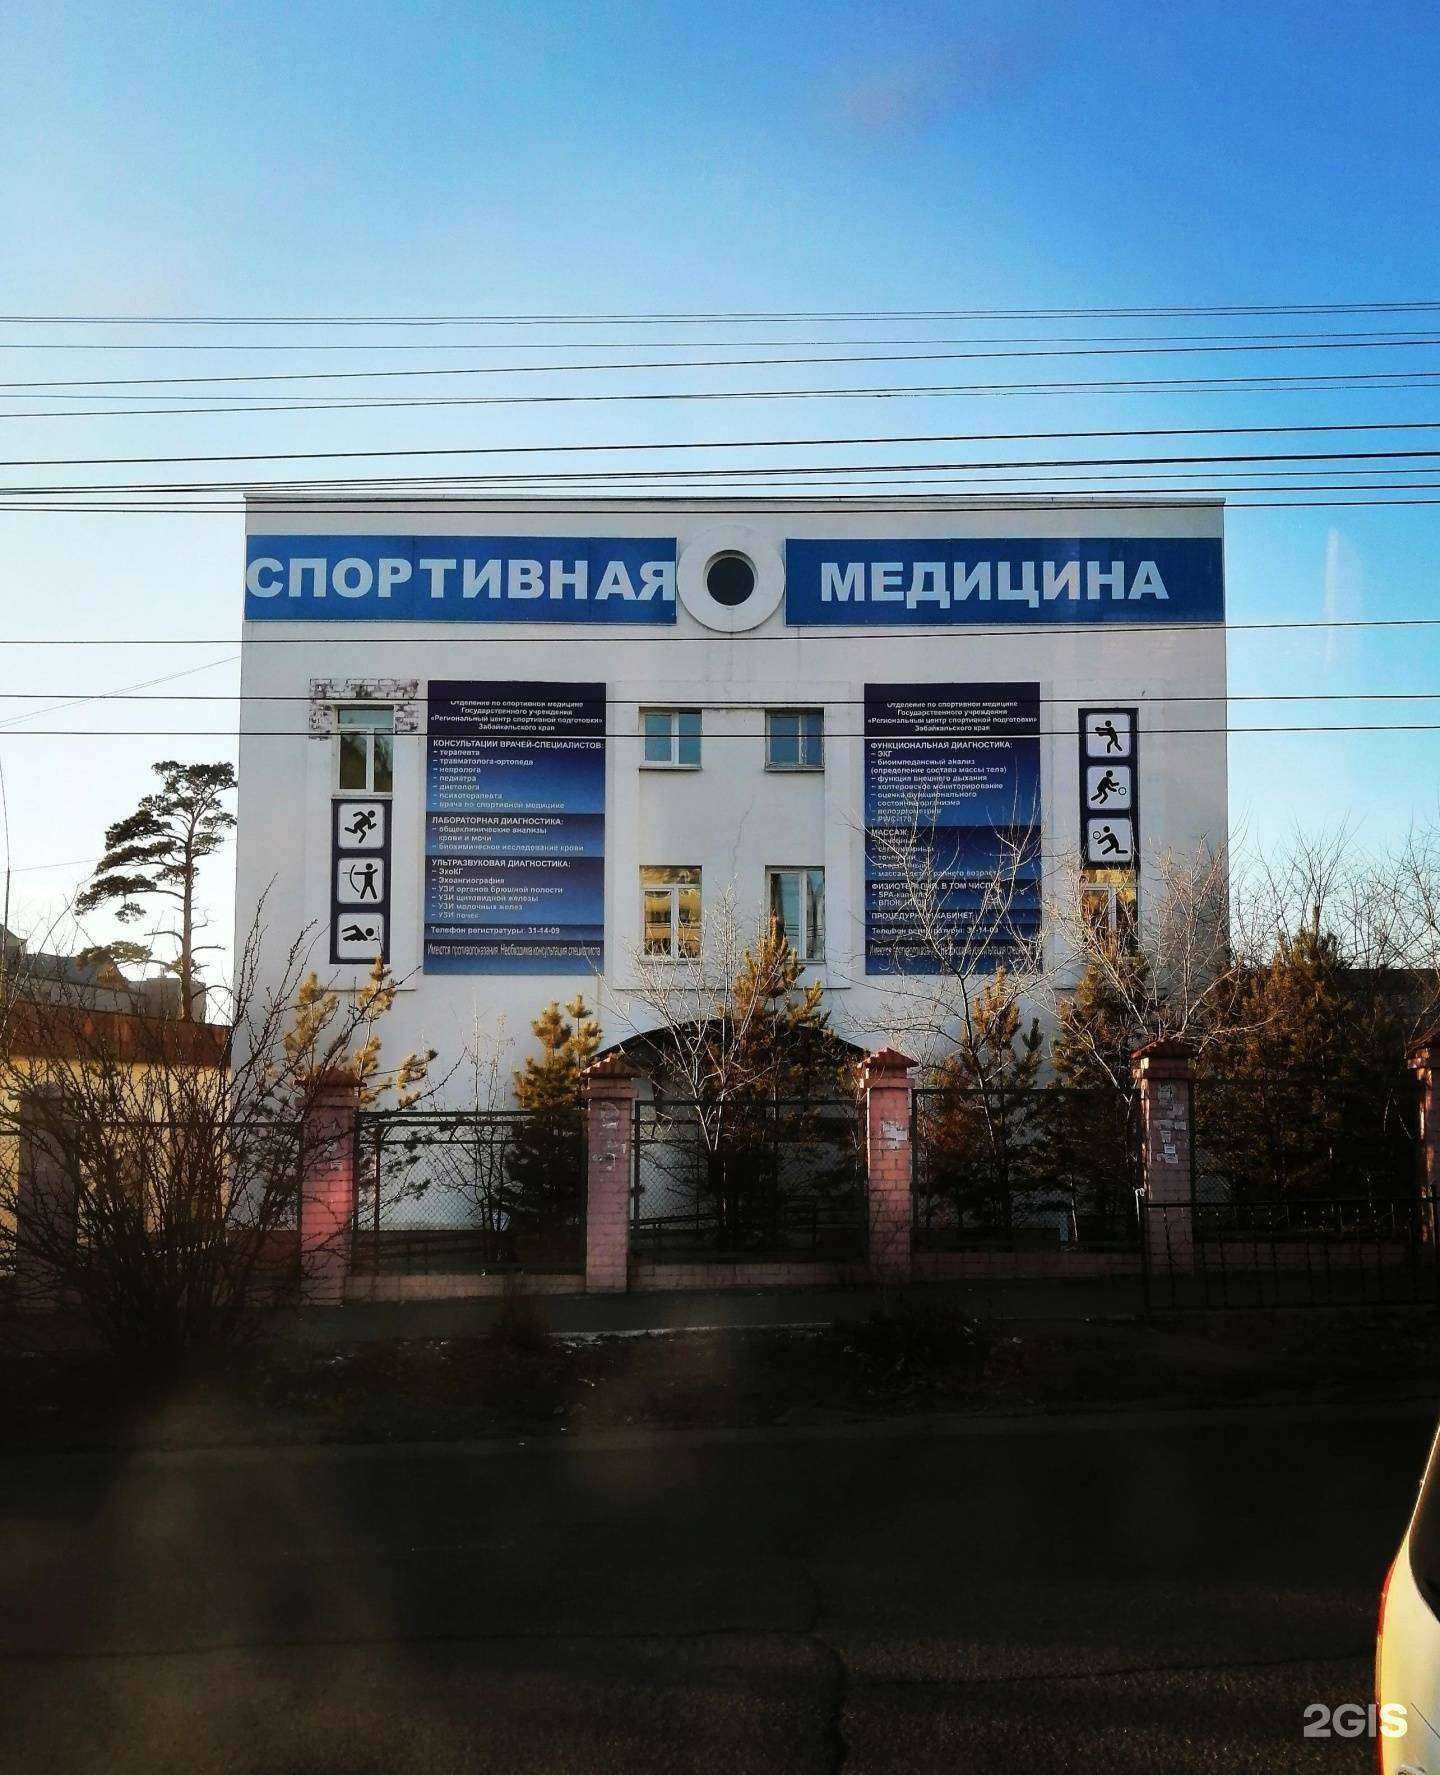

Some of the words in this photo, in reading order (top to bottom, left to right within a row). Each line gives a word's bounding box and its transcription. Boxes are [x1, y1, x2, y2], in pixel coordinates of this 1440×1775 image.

[246, 557, 675, 601] СПОРТИВНАЯ
[821, 560, 1169, 609] МЕДИЦИНА
[461, 707, 527, 716] Государственного
[529, 707, 573, 716] учреждения
[897, 709, 962, 717] Государственного
[964, 709, 1008, 717] учреждения
[490, 715, 511, 723] центр
[926, 717, 947, 725] центр
[478, 723, 537, 731] Забайкальского
[433, 739, 498, 748] КОНСУЛЬТАЦИИ
[500, 740, 605, 749] ВРАЧЕЙ-СПЕЦИАЛИСТОВ:
[871, 742, 949, 750] ФУНКЦИОНАЛЬНАЯ
[951, 742, 1013, 750] ДИАГНОСТИКА:
[440, 758, 534, 766] травматолога-ортопеда
[877, 758, 946, 766] биоимпедансный
[948, 758, 975, 766] анализ
[958, 766, 985, 774] массы
[986, 766, 1007, 774] тела)
[439, 775, 477, 783] педиатра
[914, 775, 950, 783] внешнего
[952, 775, 987, 783] дыхания
[439, 792, 503, 800] психотерапевта
[432, 816, 499, 825] ЛАБОРАТОРНАЯ
[500, 817, 564, 826] ДИАГНОСТИКА:
[439, 826, 510, 834] общеклинические
[512, 826, 547, 834] анализы
[432, 859, 506, 867] УЛЬТРАЗВУКОВАЯ
[507, 860, 571, 868] ДИАГНОСТИКА:
[456, 887, 489, 895] органов
[490, 886, 528, 894] брюшной
[431, 926, 466, 935] Телефон
[468, 926, 526, 935] регистратуры:
[528, 926, 560, 935] 31-14-09
